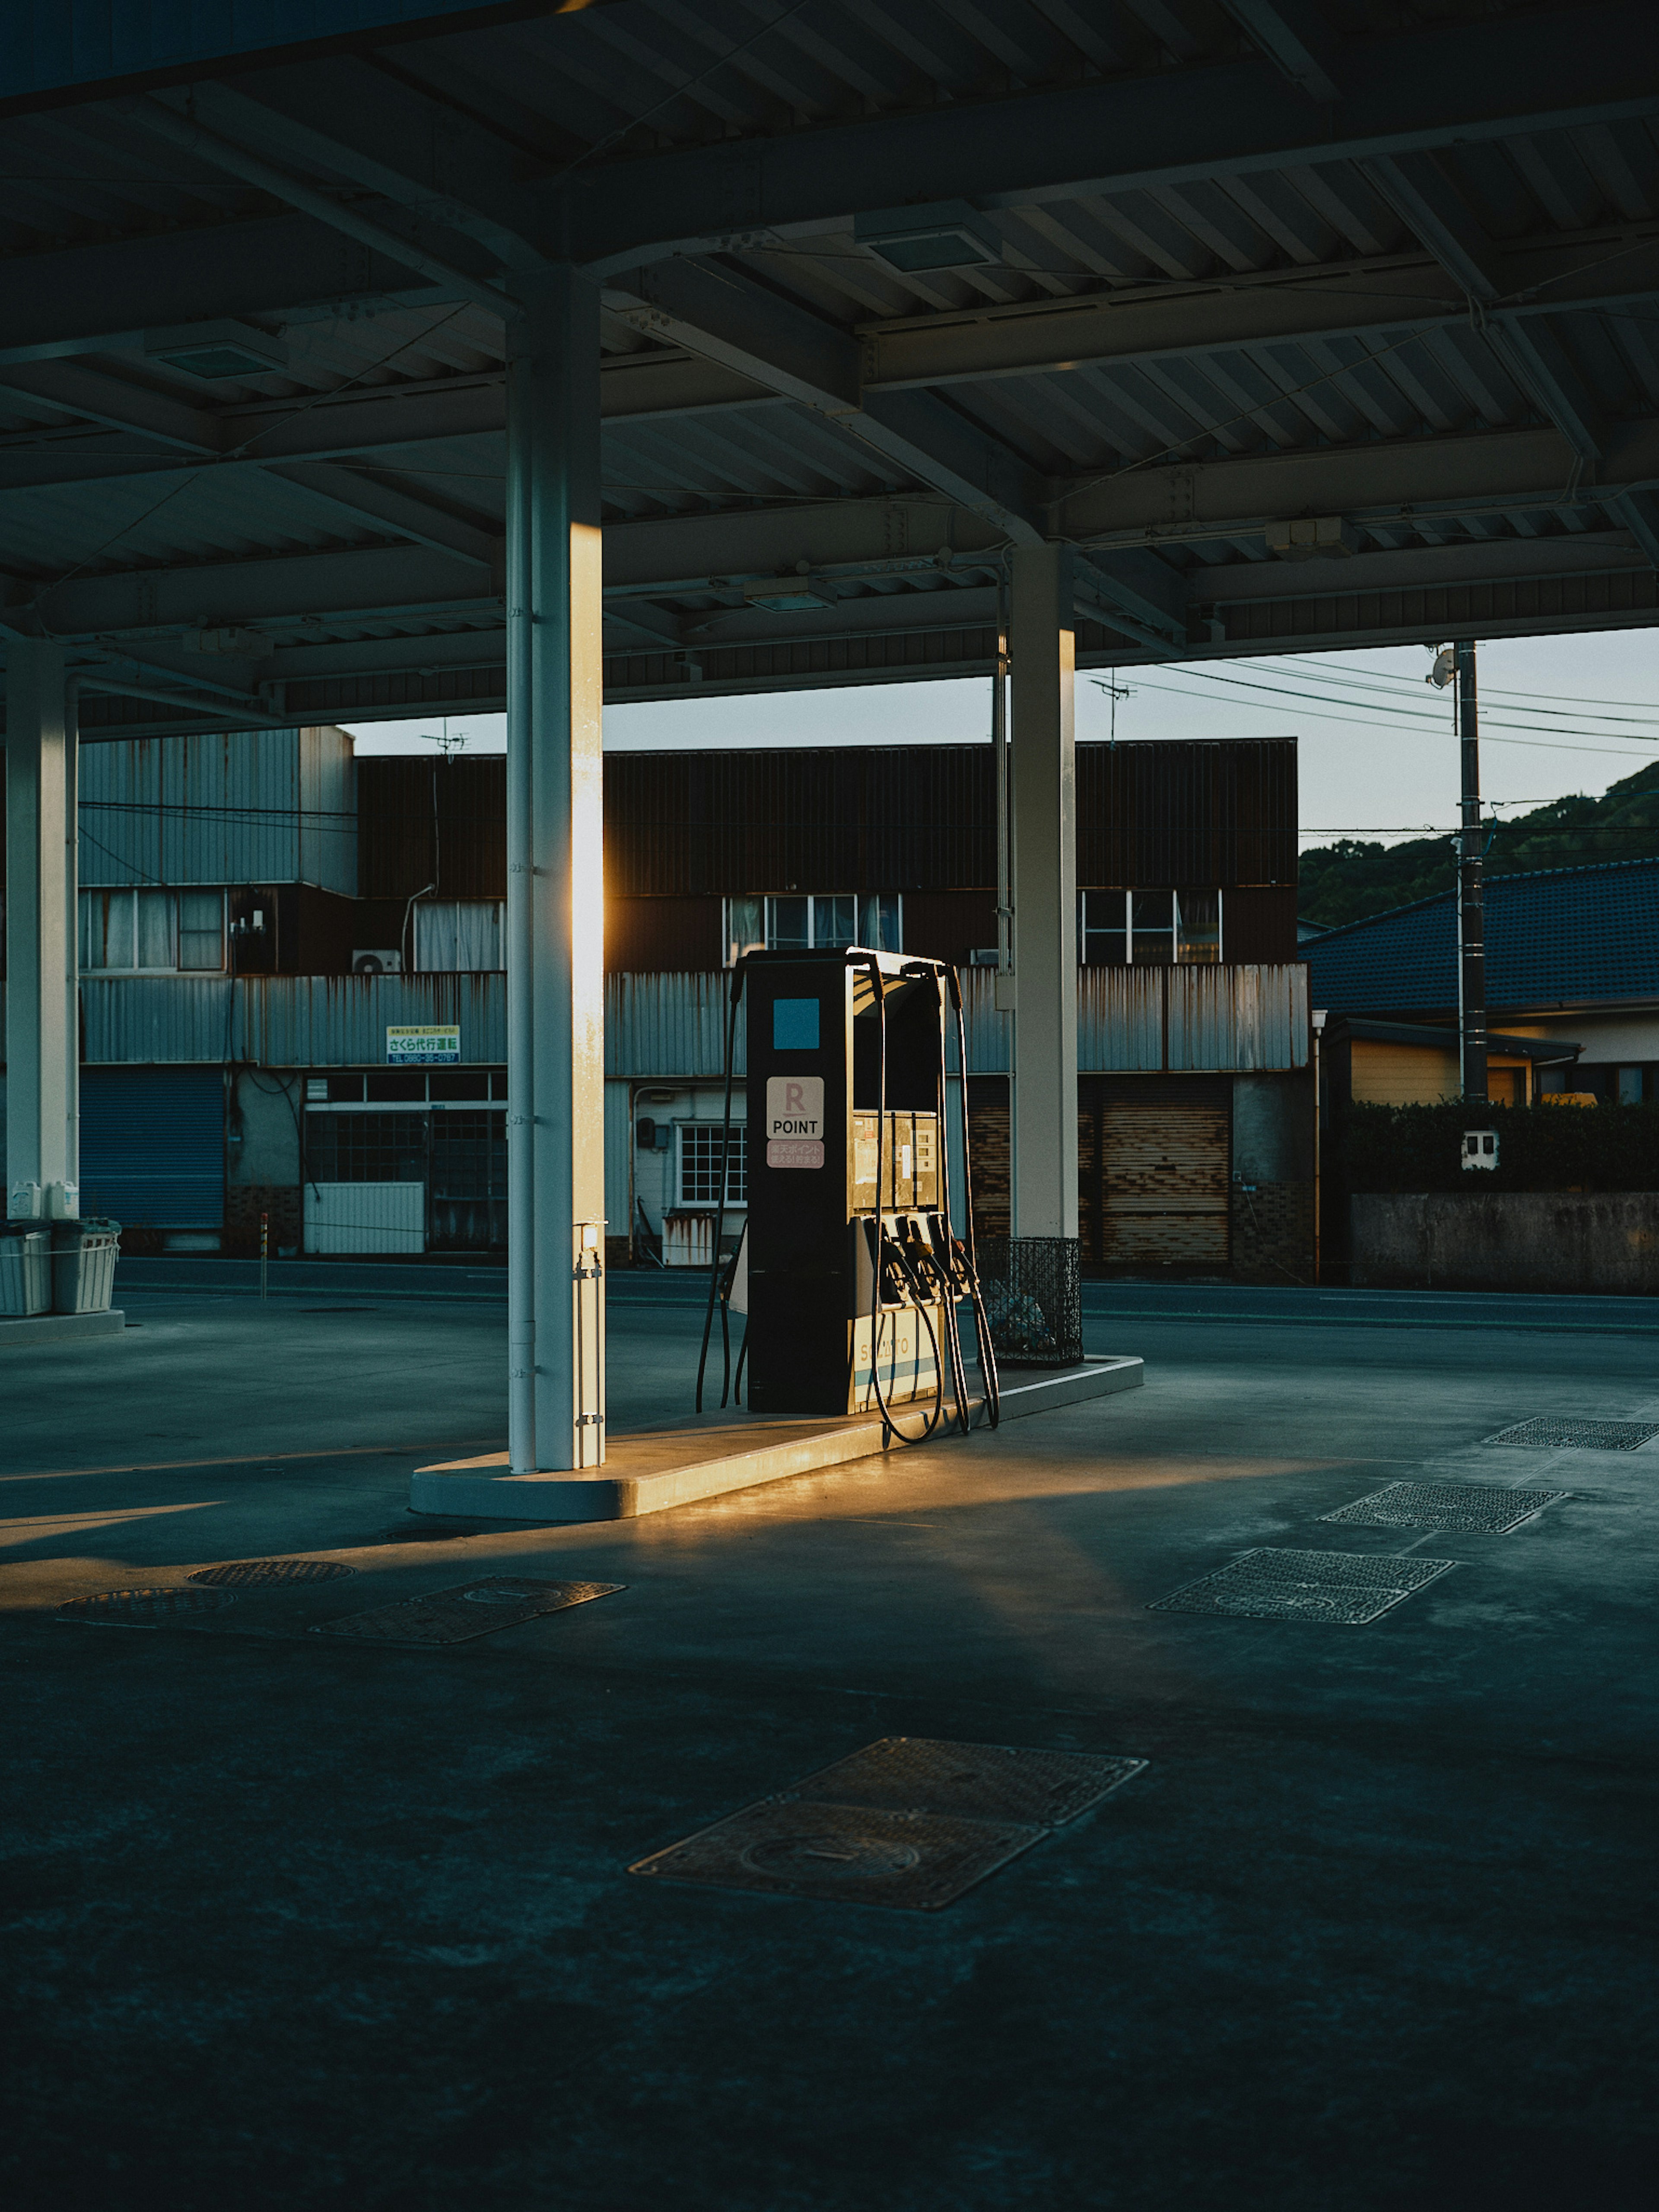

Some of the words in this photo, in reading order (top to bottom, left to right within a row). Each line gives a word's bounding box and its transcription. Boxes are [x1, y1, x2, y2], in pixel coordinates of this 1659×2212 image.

[390, 1037, 457, 1051] さくら代行運転
[786, 1083, 806, 1111] R
[773, 1120, 818, 1134] POINT
[771, 1144, 820, 1154] 楽天ポイント
